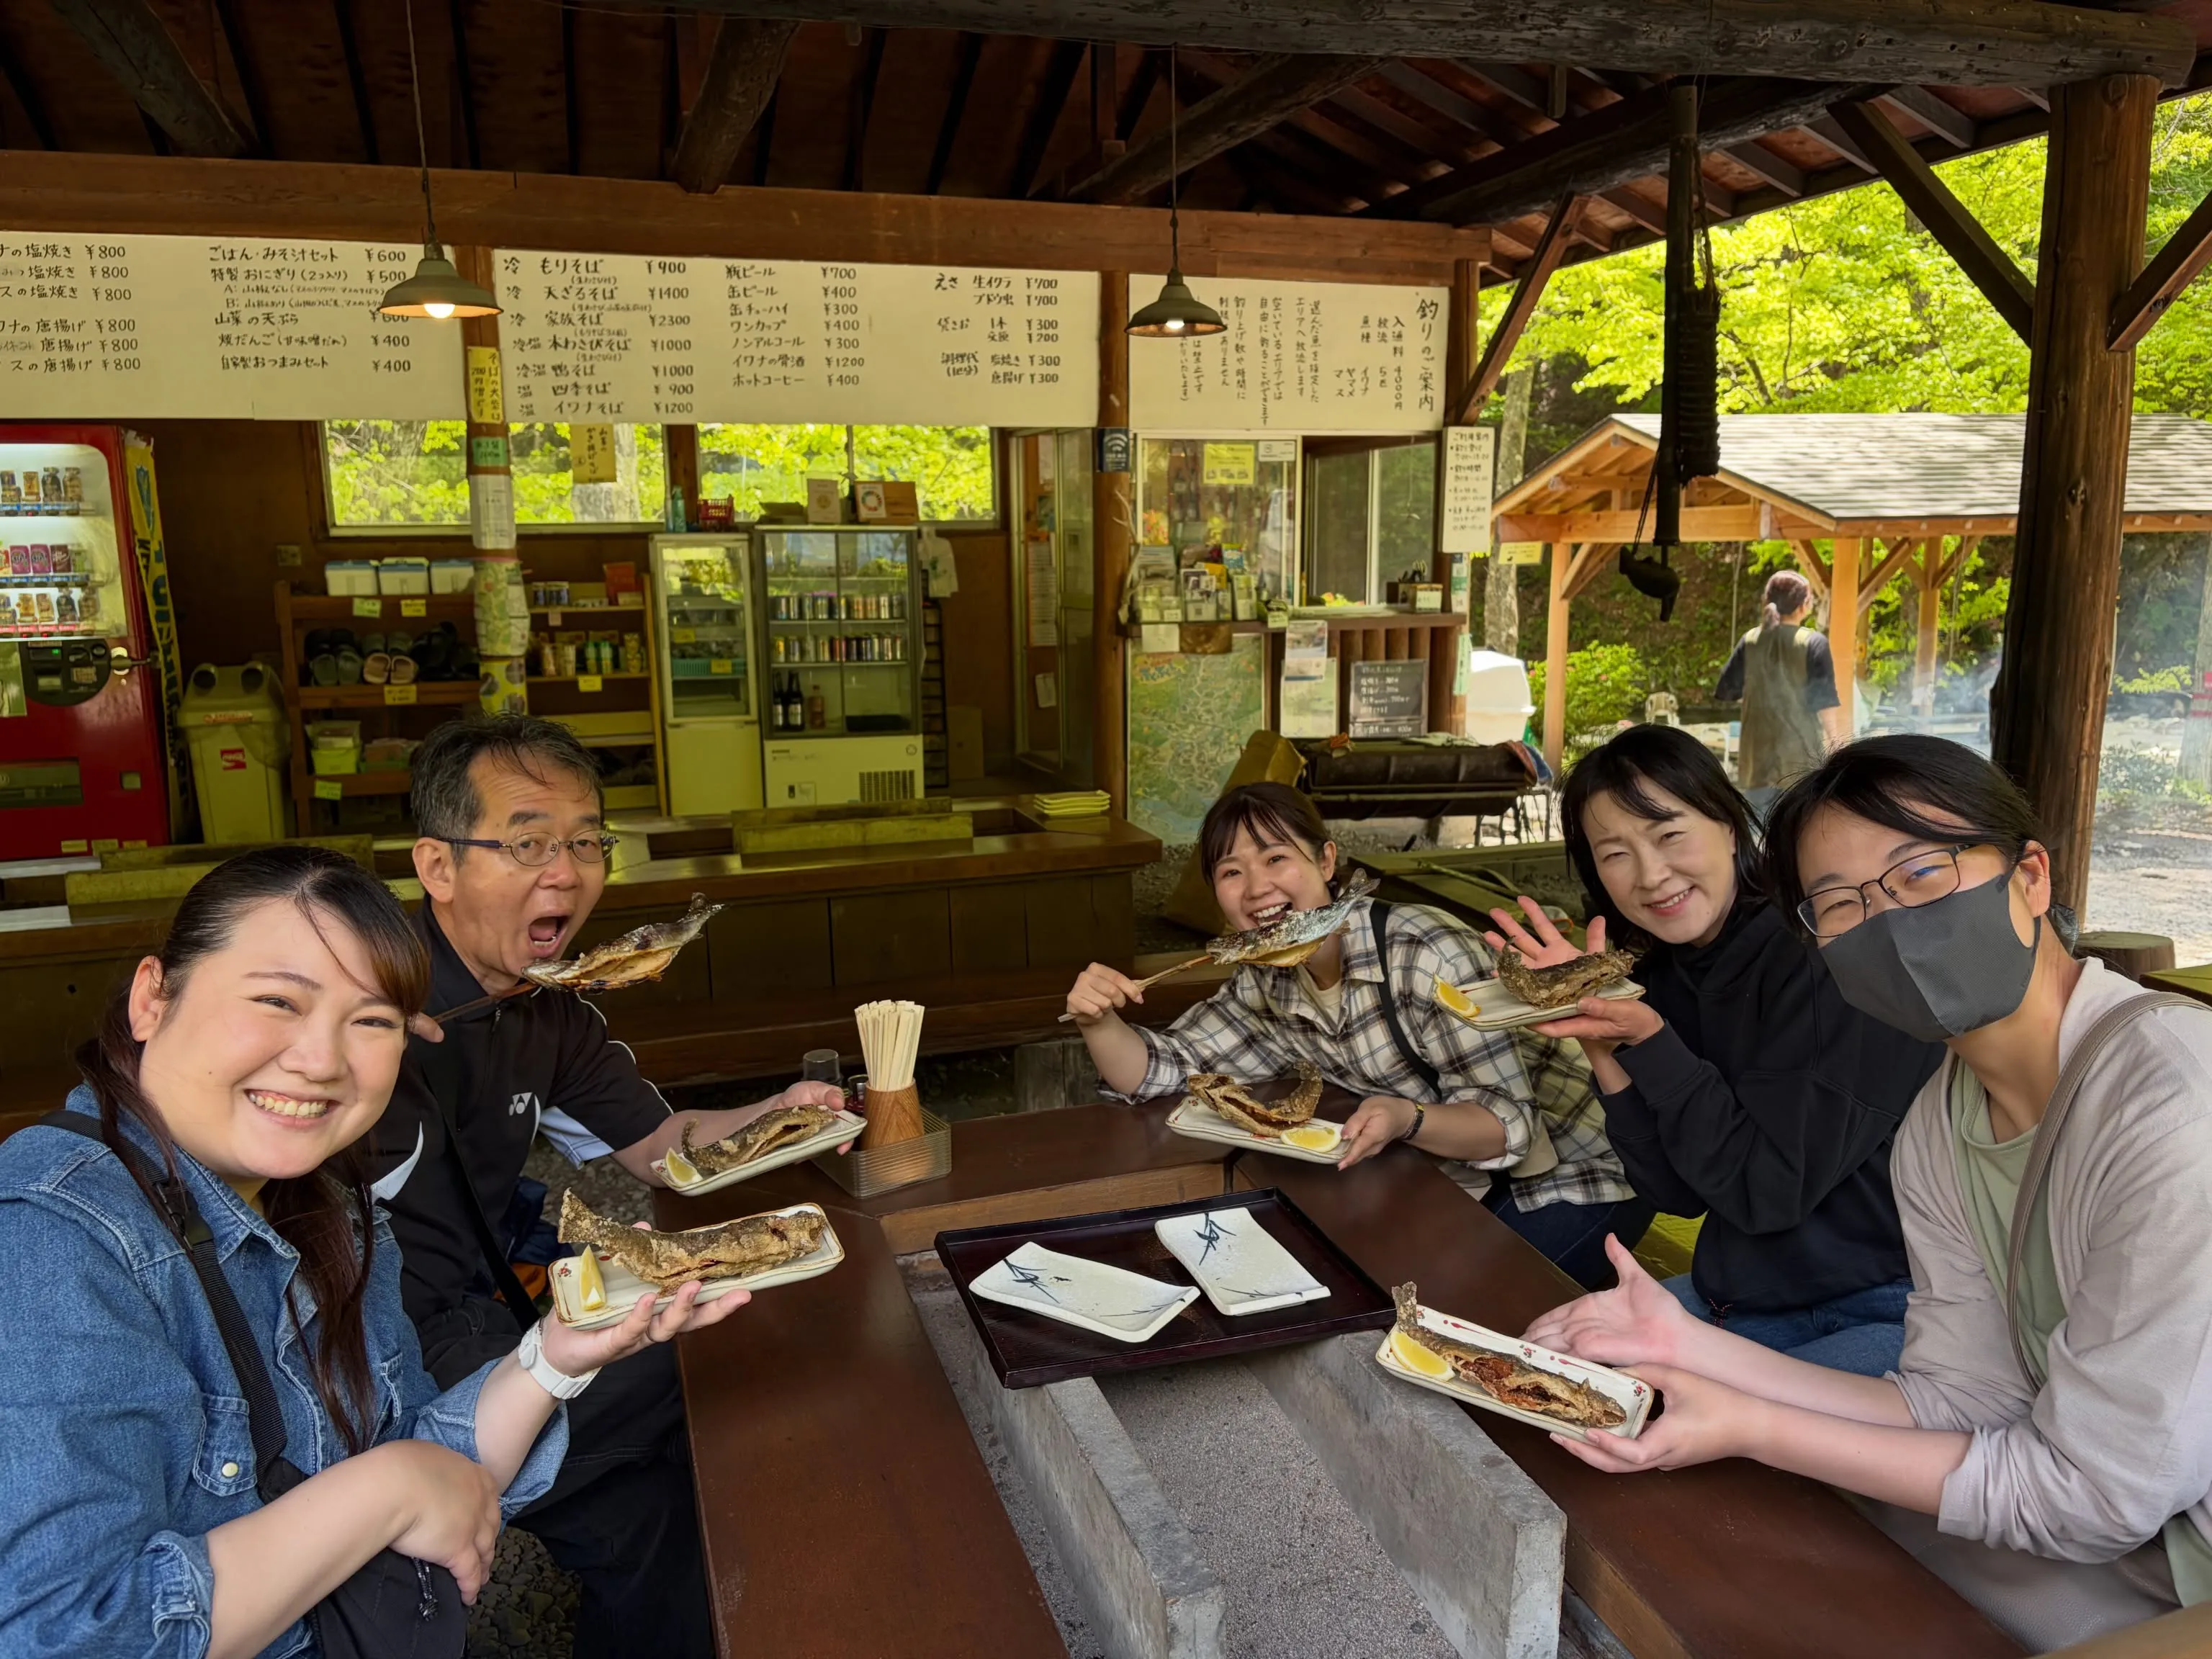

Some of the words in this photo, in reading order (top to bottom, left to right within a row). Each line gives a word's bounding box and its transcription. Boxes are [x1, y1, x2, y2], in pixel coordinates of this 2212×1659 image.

[86, 245, 126, 259] ¥800
[365, 249, 406, 262] ¥600
[541, 257, 603, 274] もりそば
[646, 260, 686, 274] ¥900
[89, 266, 128, 279] ¥800
[367, 270, 407, 284] ¥500
[821, 266, 856, 279] ¥700
[935, 273, 958, 290] えさ
[973, 275, 1012, 289] 生イクラ
[1025, 276, 1058, 289] ¥700
[92, 288, 132, 301] ¥800
[544, 285, 619, 301] 天ざるそば
[648, 287, 689, 301] ¥1400
[728, 285, 778, 299] 缶ビール
[822, 287, 857, 298] ¥400
[1026, 295, 1058, 307] ¥700
[729, 303, 788, 316] 缶チューハイ
[824, 303, 858, 315] ¥300
[96, 319, 135, 333] ¥800
[545, 311, 603, 327] 家族そば
[649, 313, 691, 328] ¥2300
[730, 319, 787, 333] ワンカップ
[824, 320, 860, 331] ¥400
[1026, 319, 1058, 331] ¥300
[99, 338, 138, 352] ¥800
[371, 334, 410, 348] ¥400
[651, 338, 691, 351] ¥1000
[732, 336, 805, 349] ノンアルコール
[1027, 333, 1058, 344] ¥200
[733, 354, 805, 368] イワナの骨酒
[825, 356, 865, 368] ¥1200
[1029, 355, 1061, 367] ¥300
[1416, 299, 1439, 412] 釣りのご案内
[102, 358, 140, 372] ¥800
[372, 359, 411, 372] ¥400
[652, 365, 693, 378] ¥1000
[733, 373, 805, 387] ホットコーヒー
[827, 374, 860, 387] ¥400
[1030, 373, 1059, 384] ¥300
[654, 402, 693, 414] ¥1200
